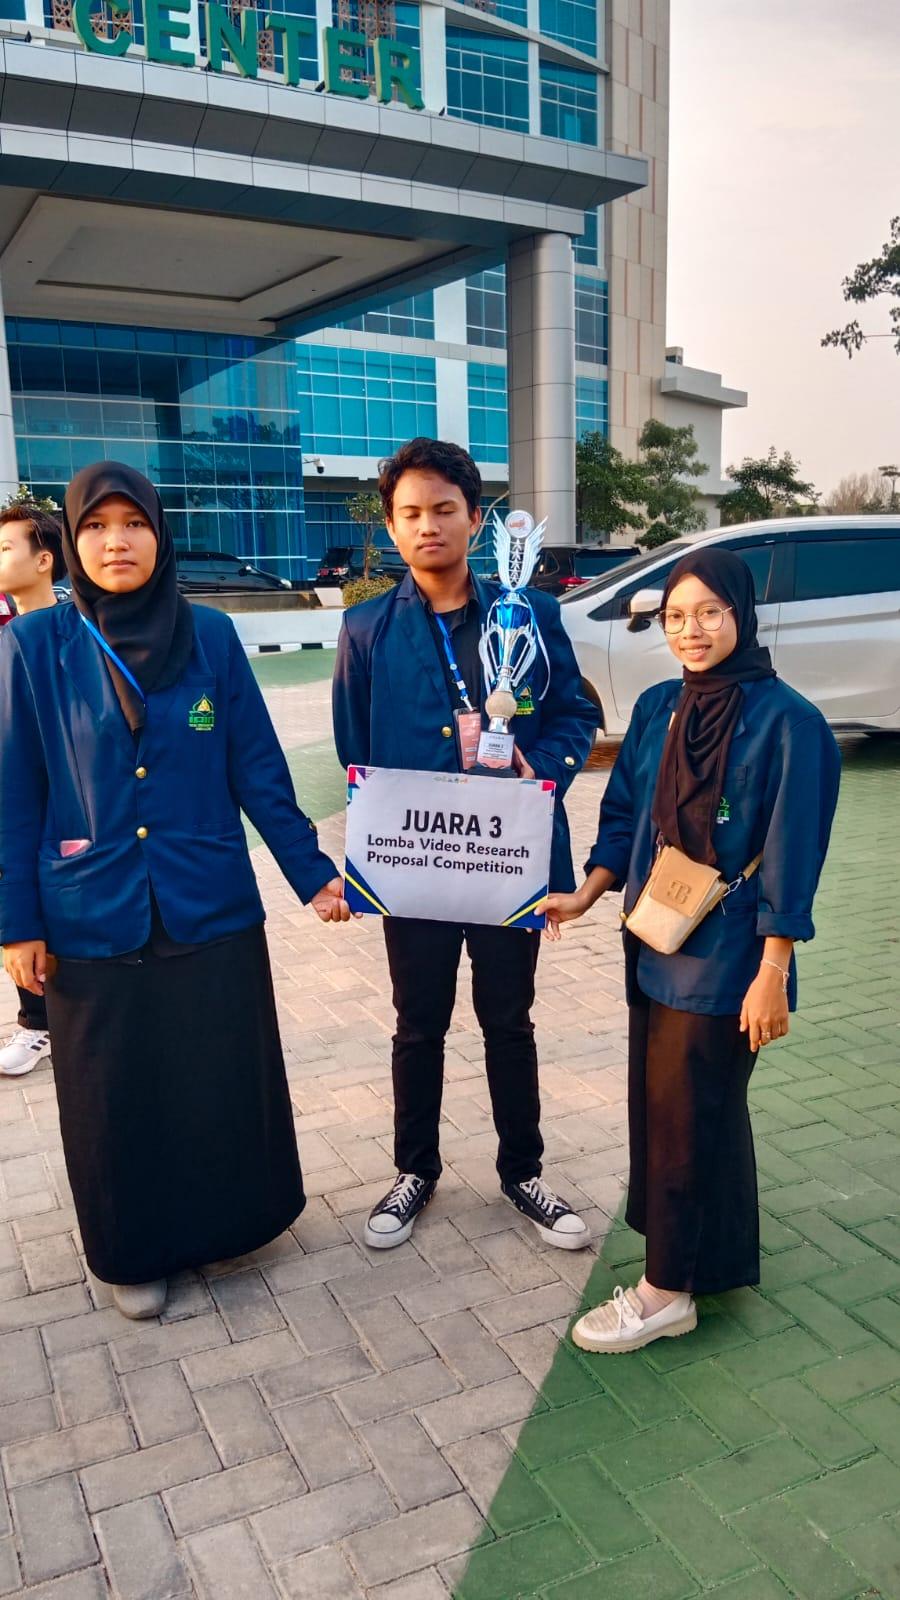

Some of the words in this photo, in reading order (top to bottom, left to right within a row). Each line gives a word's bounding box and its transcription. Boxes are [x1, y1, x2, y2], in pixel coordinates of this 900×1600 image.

[73, 0, 425, 110] CENTER
[402, 809, 482, 837] JUARA
[489, 815, 502, 839] 3
[367, 833, 415, 850] Lomba
[420, 837, 461, 853] Video
[466, 841, 530, 859] Research
[367, 851, 428, 868] Proposal
[433, 855, 523, 875] Competition
